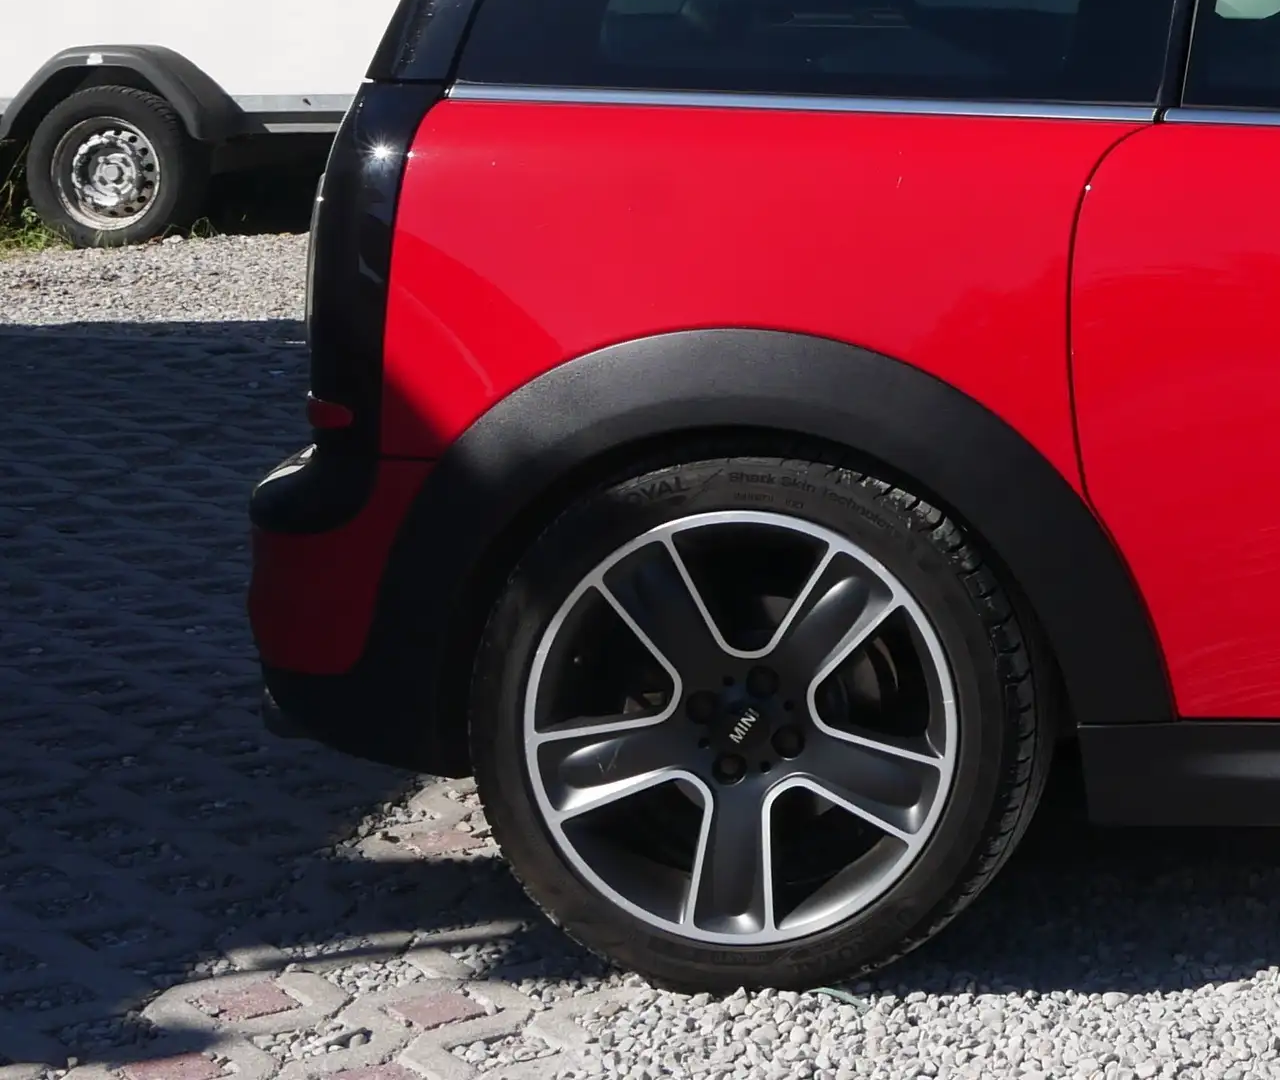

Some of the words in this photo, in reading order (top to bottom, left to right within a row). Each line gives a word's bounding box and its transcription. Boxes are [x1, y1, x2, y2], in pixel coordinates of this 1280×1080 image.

[729, 472, 776, 484] Shark
[781, 476, 816, 493] Skin
[729, 707, 760, 744] MINI
